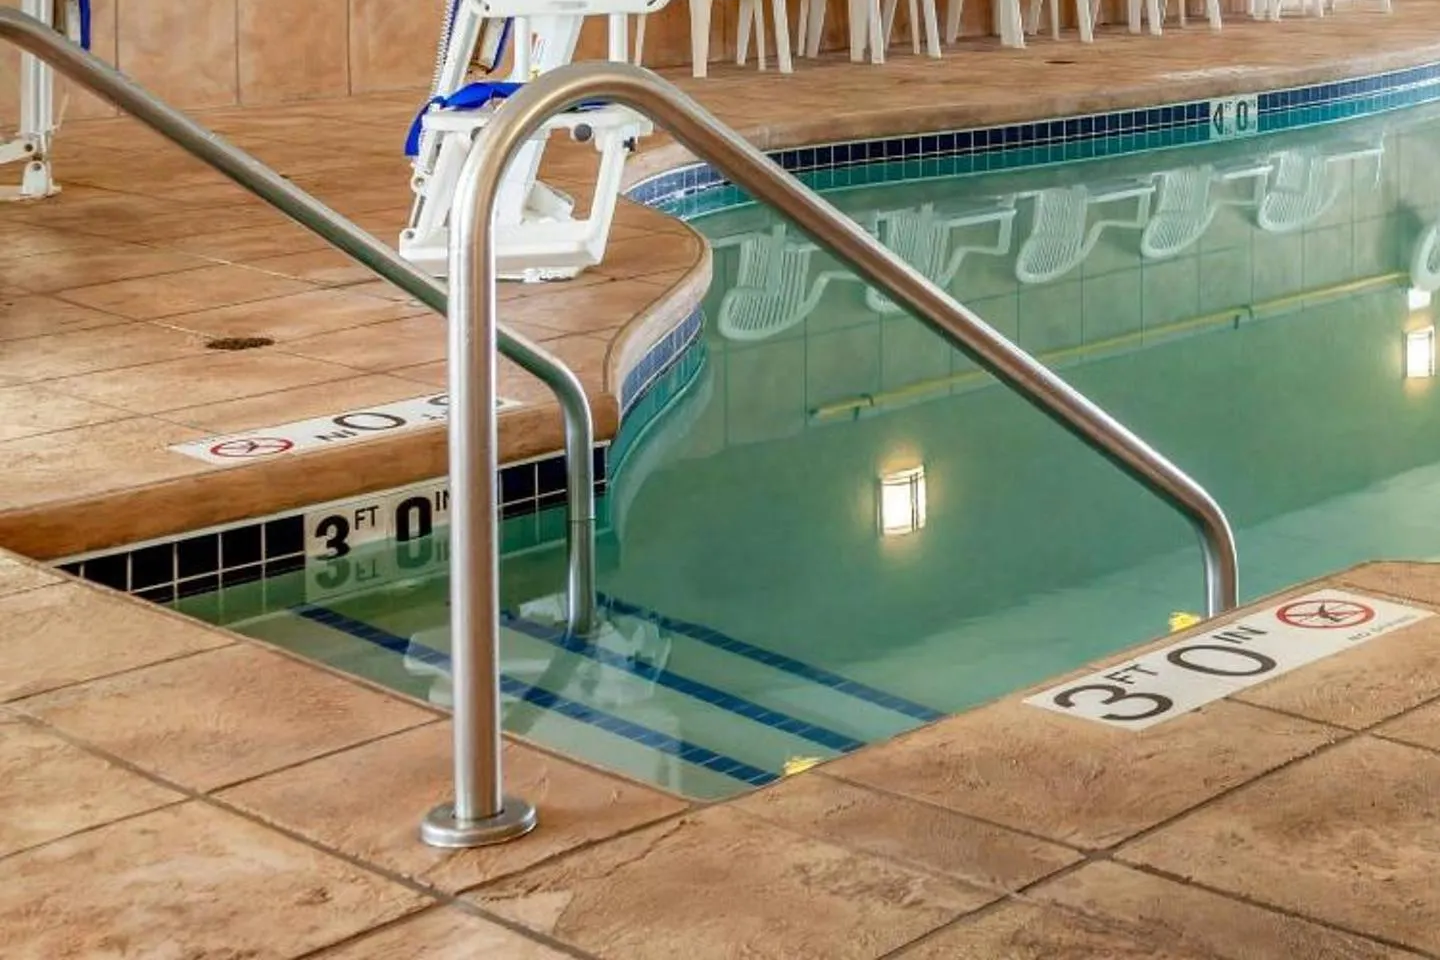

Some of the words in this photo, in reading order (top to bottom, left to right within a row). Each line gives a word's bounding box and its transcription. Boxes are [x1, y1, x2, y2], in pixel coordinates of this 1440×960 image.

[1213, 102, 1223, 121] 4
[1236, 100, 1248, 121] 0
[315, 515, 351, 560] 3
[355, 505, 379, 530] FT
[396, 496, 432, 542] 0
[1212, 625, 1268, 644] IN
[1167, 645, 1277, 676] 0
[1104, 664, 1158, 685] FT
[1054, 685, 1173, 721] 3
